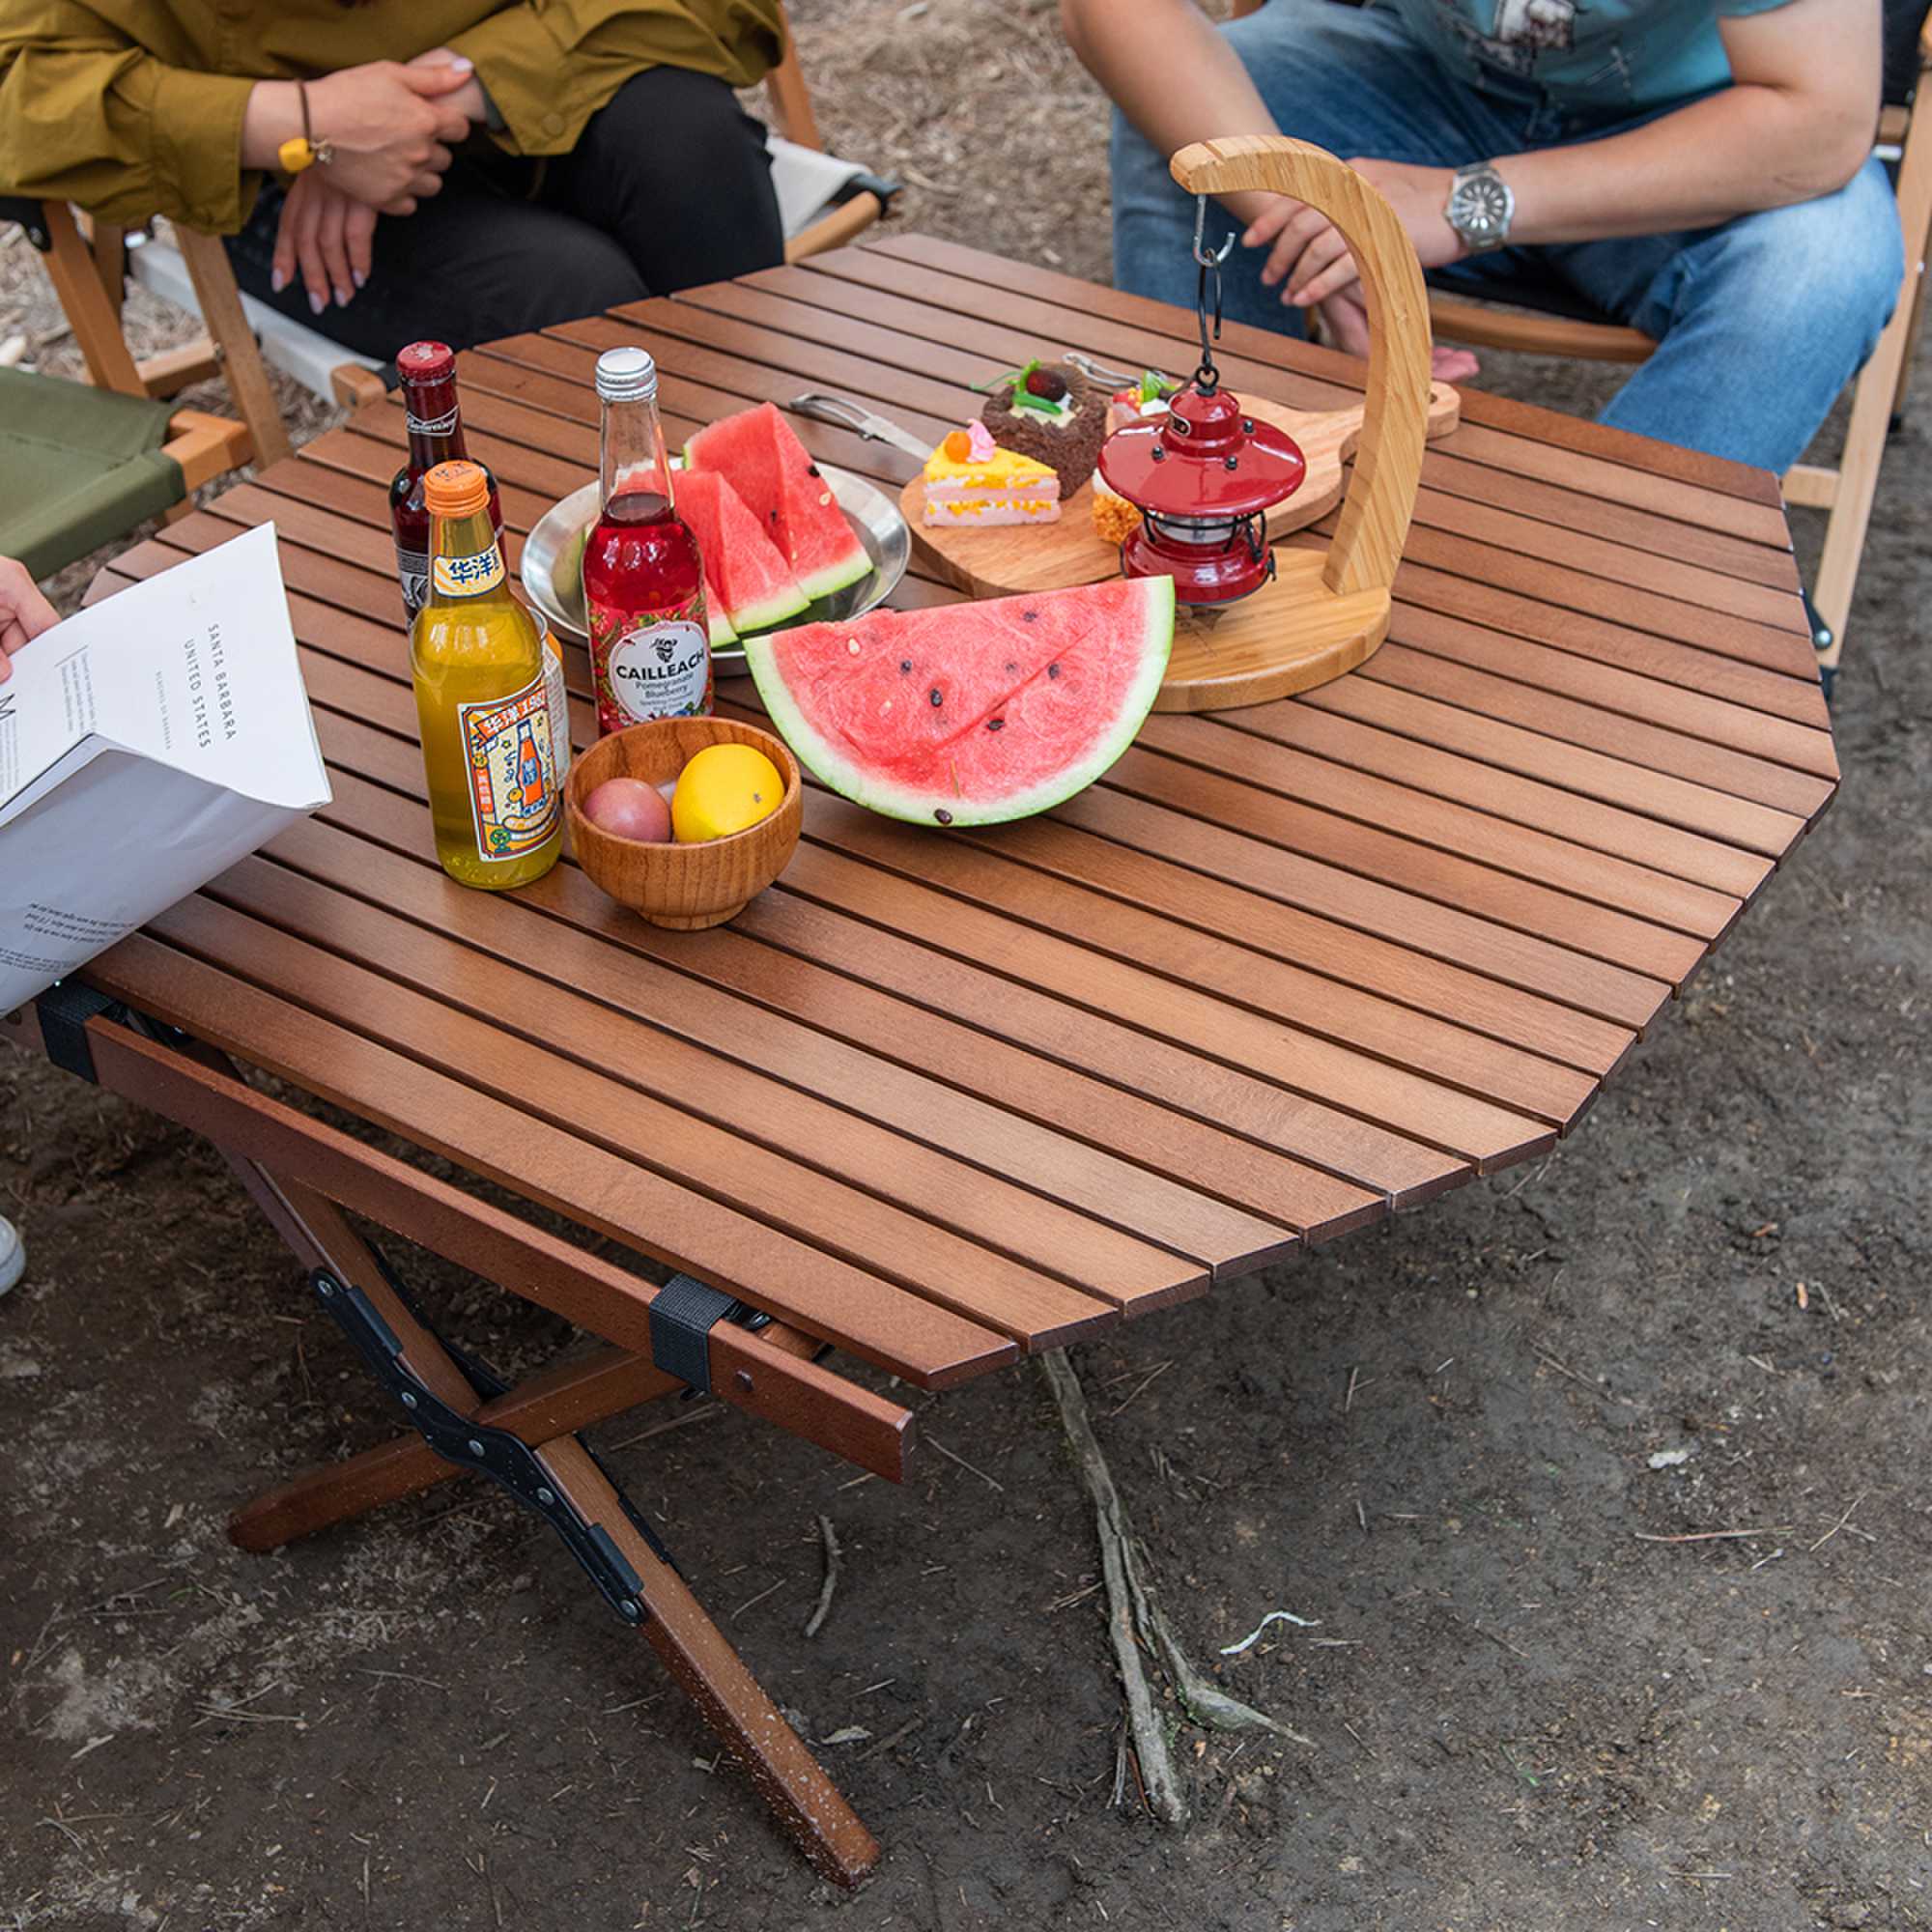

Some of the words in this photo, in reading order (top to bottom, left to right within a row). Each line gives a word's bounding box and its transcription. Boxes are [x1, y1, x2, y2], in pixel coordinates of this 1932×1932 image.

[185, 638, 202, 691] UNITED
[208, 623, 224, 668] SANTA
[616, 649, 706, 680] CAILLEACH
[192, 695, 212, 748] STATES
[215, 671, 237, 740] BARBARA
